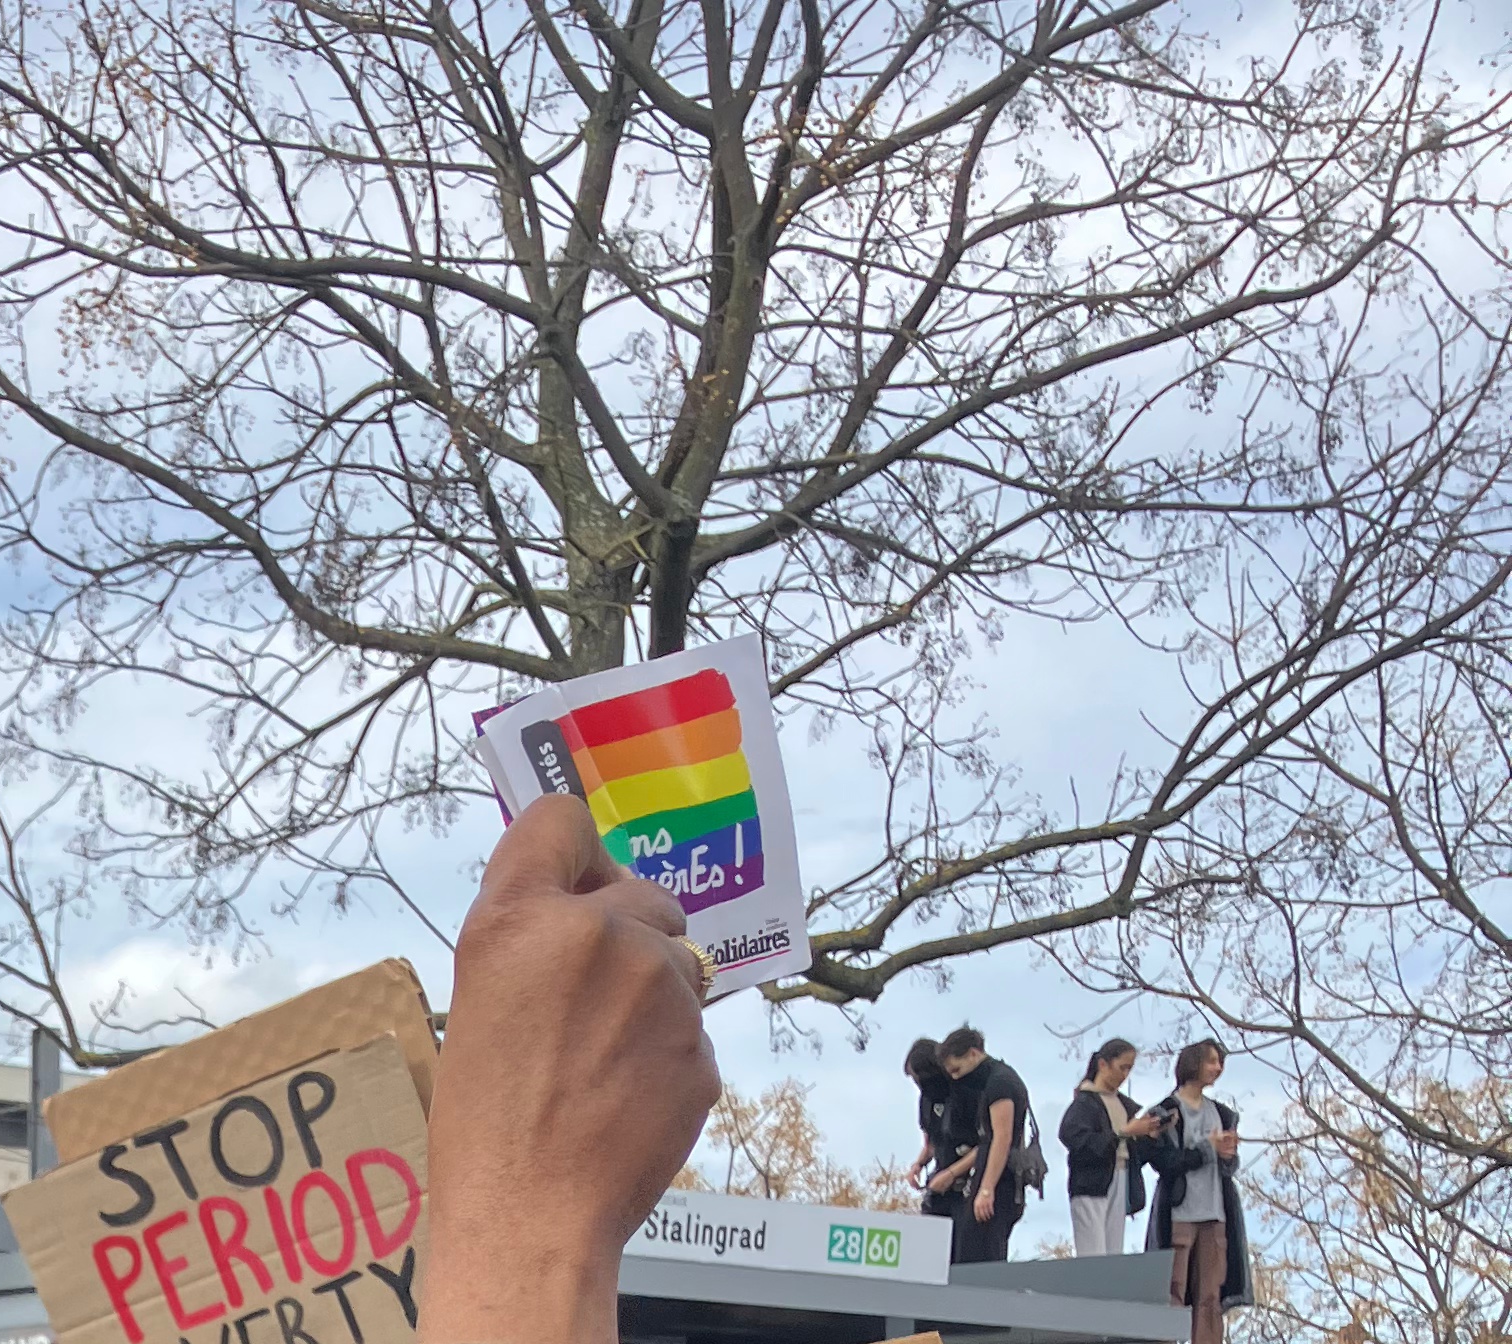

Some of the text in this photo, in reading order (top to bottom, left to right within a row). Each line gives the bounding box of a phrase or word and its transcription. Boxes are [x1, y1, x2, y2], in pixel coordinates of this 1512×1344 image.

[98, 1070, 336, 1228] STOP
[93, 1148, 421, 1344] PERIOD
[645, 1209, 766, 1255] Stalingrad
[831, 1230, 899, 1263] 28 60
